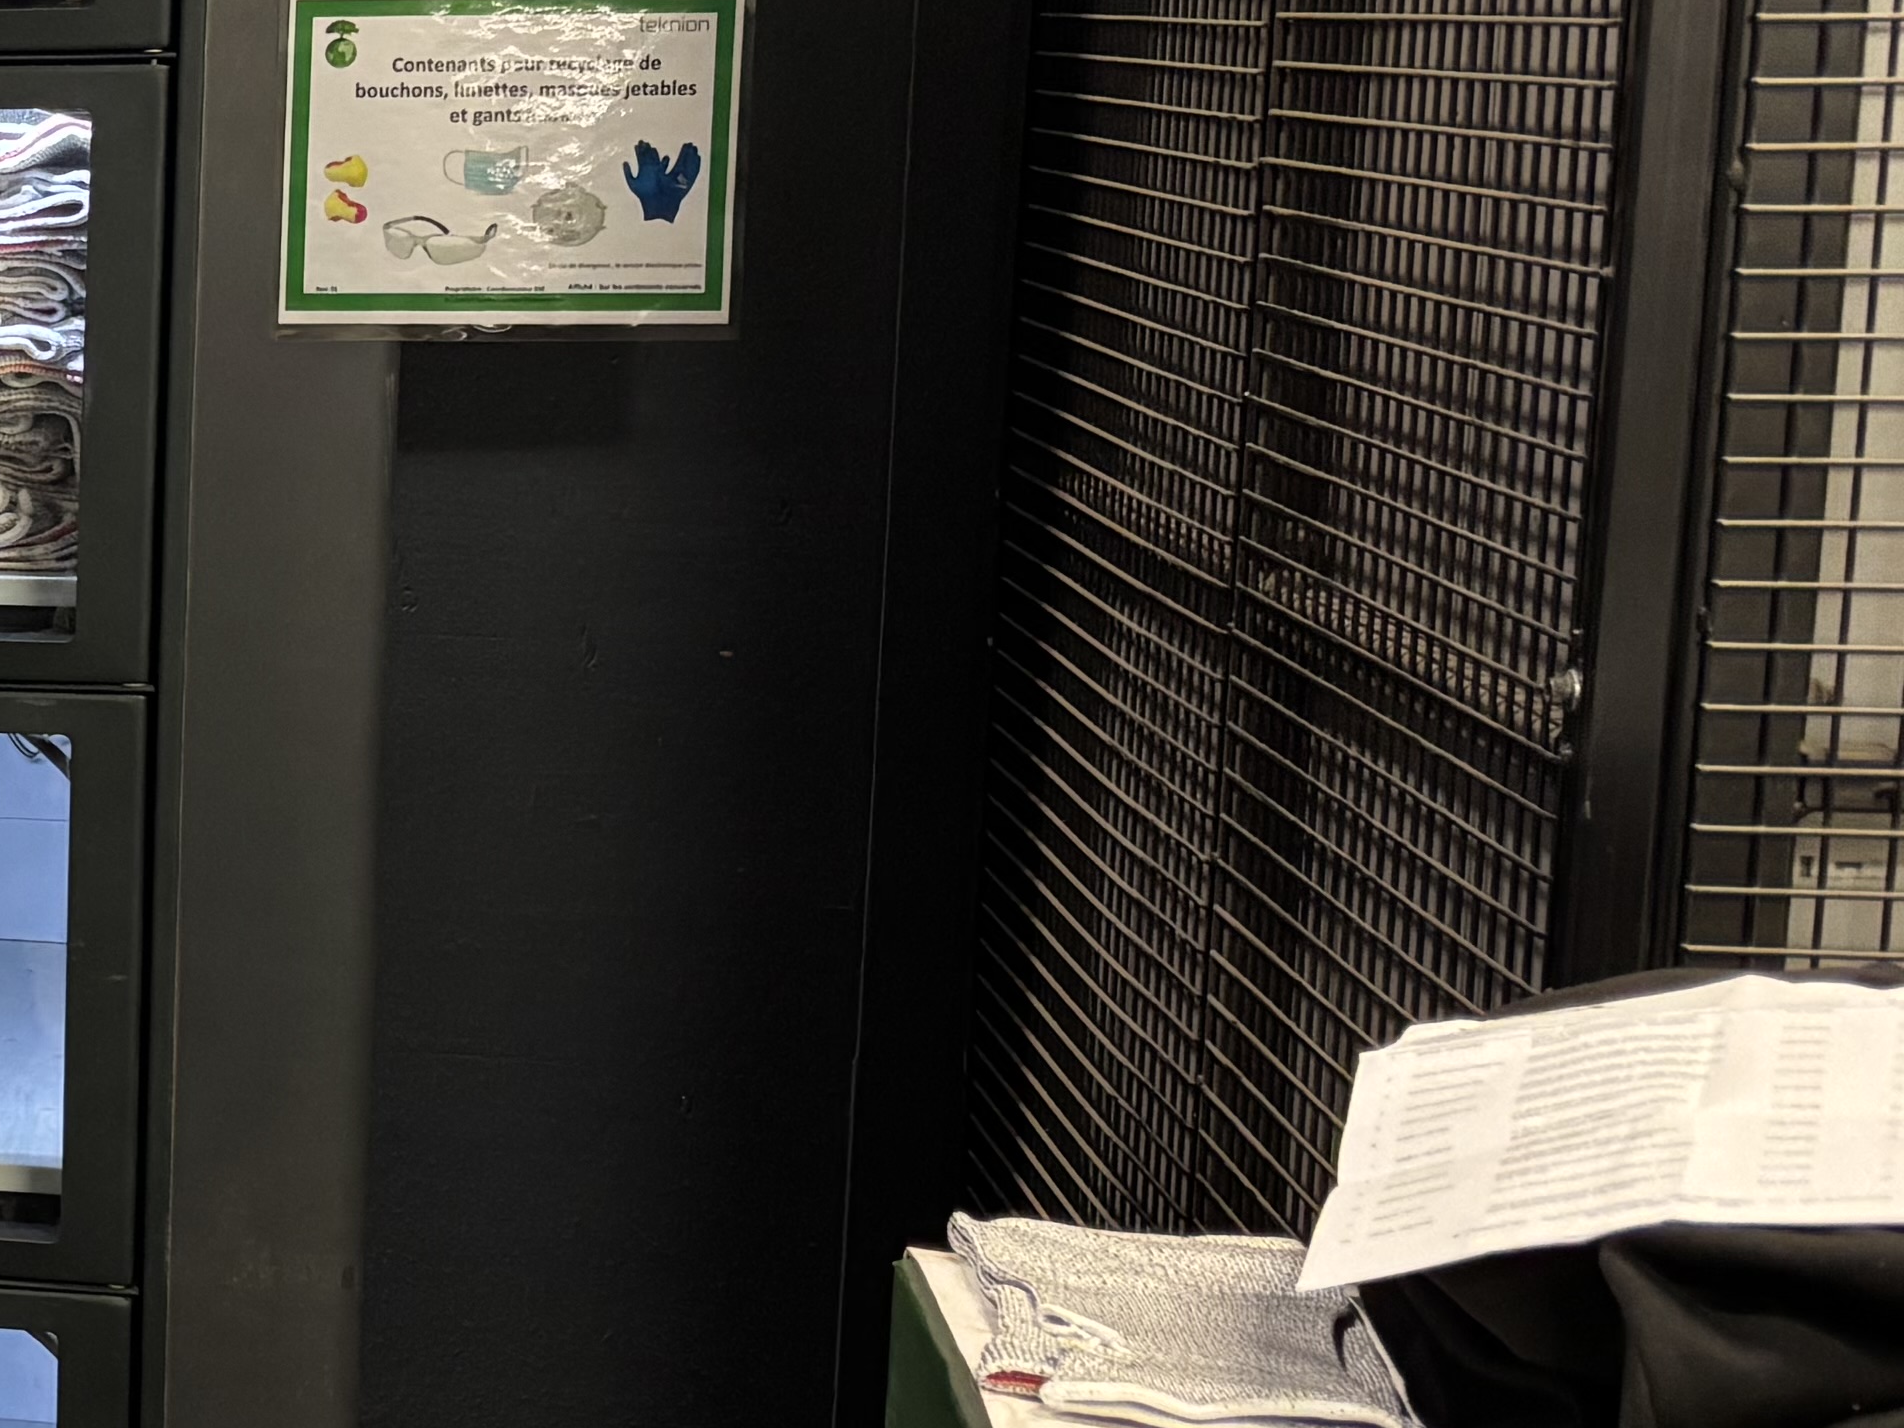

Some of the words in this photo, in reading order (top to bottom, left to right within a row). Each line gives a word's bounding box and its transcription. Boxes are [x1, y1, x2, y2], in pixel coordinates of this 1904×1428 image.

[392, 56, 496, 73] Contenants
[638, 56, 661, 71] de
[355, 82, 449, 101] bouchons,
[623, 79, 697, 99] jetables
[450, 109, 467, 123] et
[472, 109, 522, 127] gants
